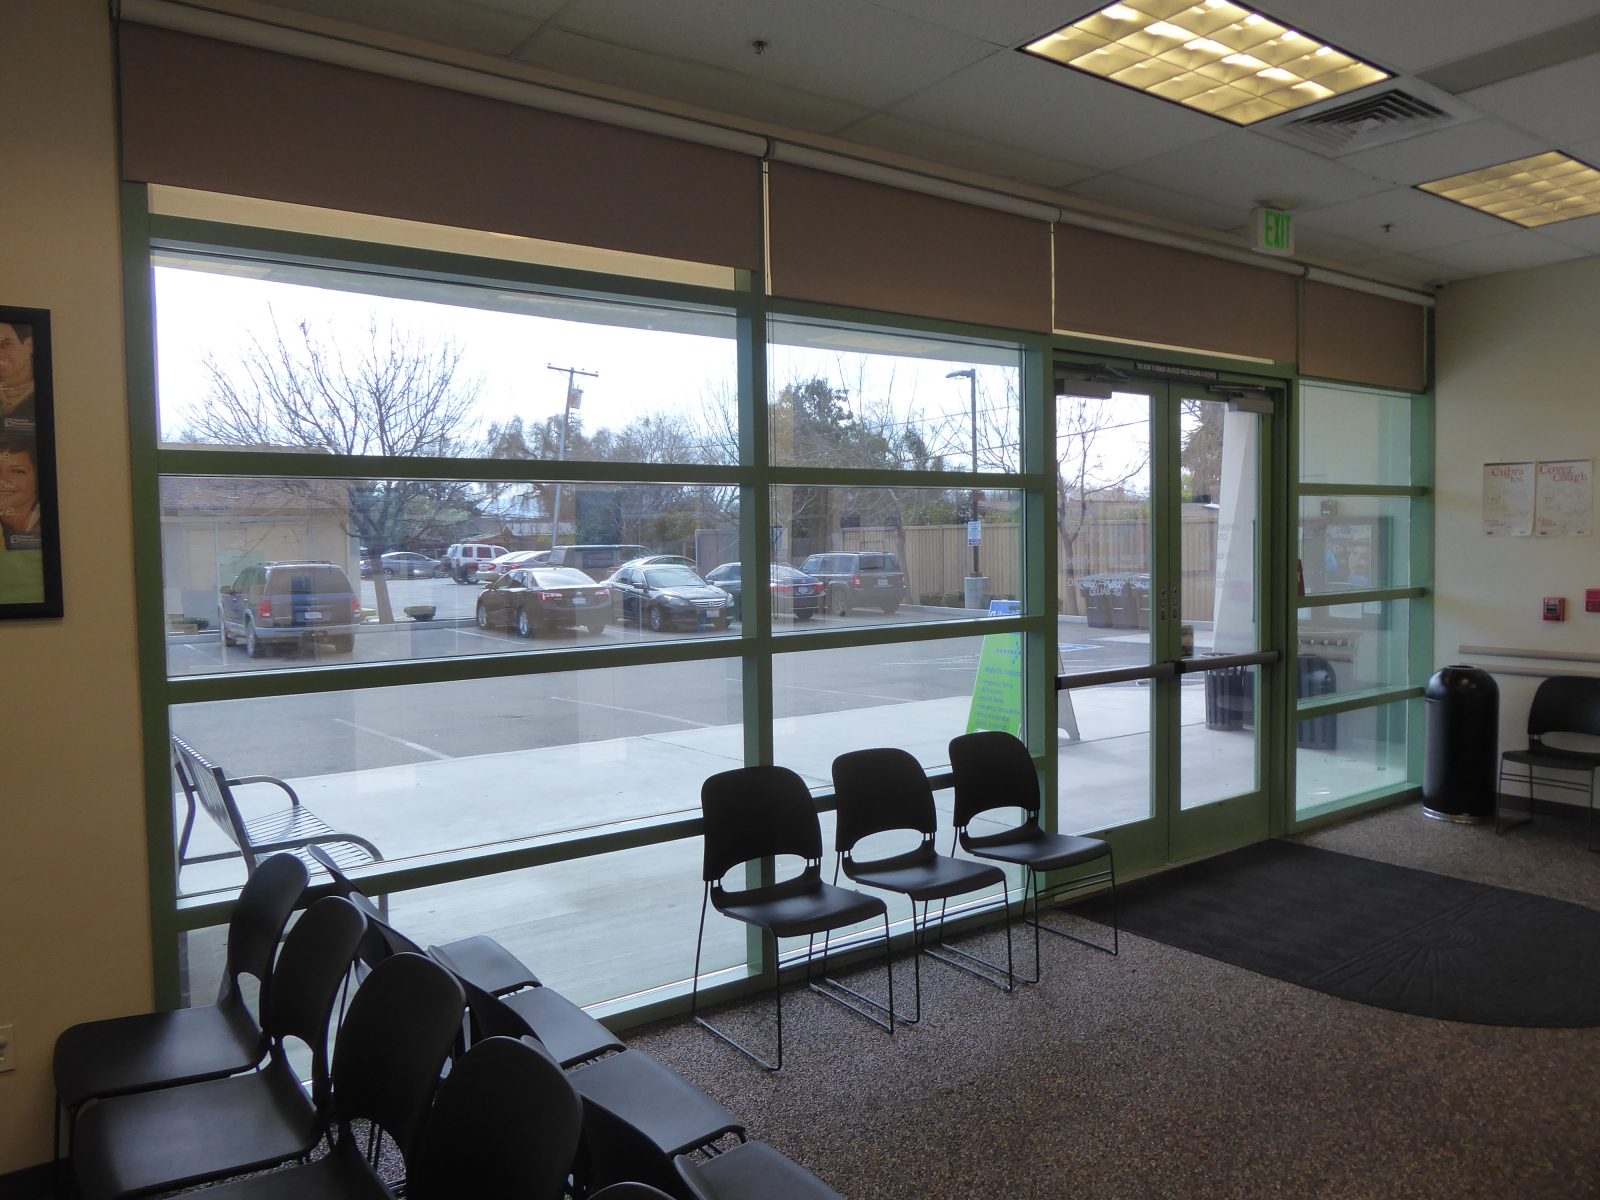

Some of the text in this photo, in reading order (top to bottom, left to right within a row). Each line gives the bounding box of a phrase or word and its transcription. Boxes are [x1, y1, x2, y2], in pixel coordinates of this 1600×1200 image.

[1264, 210, 1292, 250] EXIT
[1540, 464, 1574, 475] Cover
[1553, 472, 1588, 484] Cough
